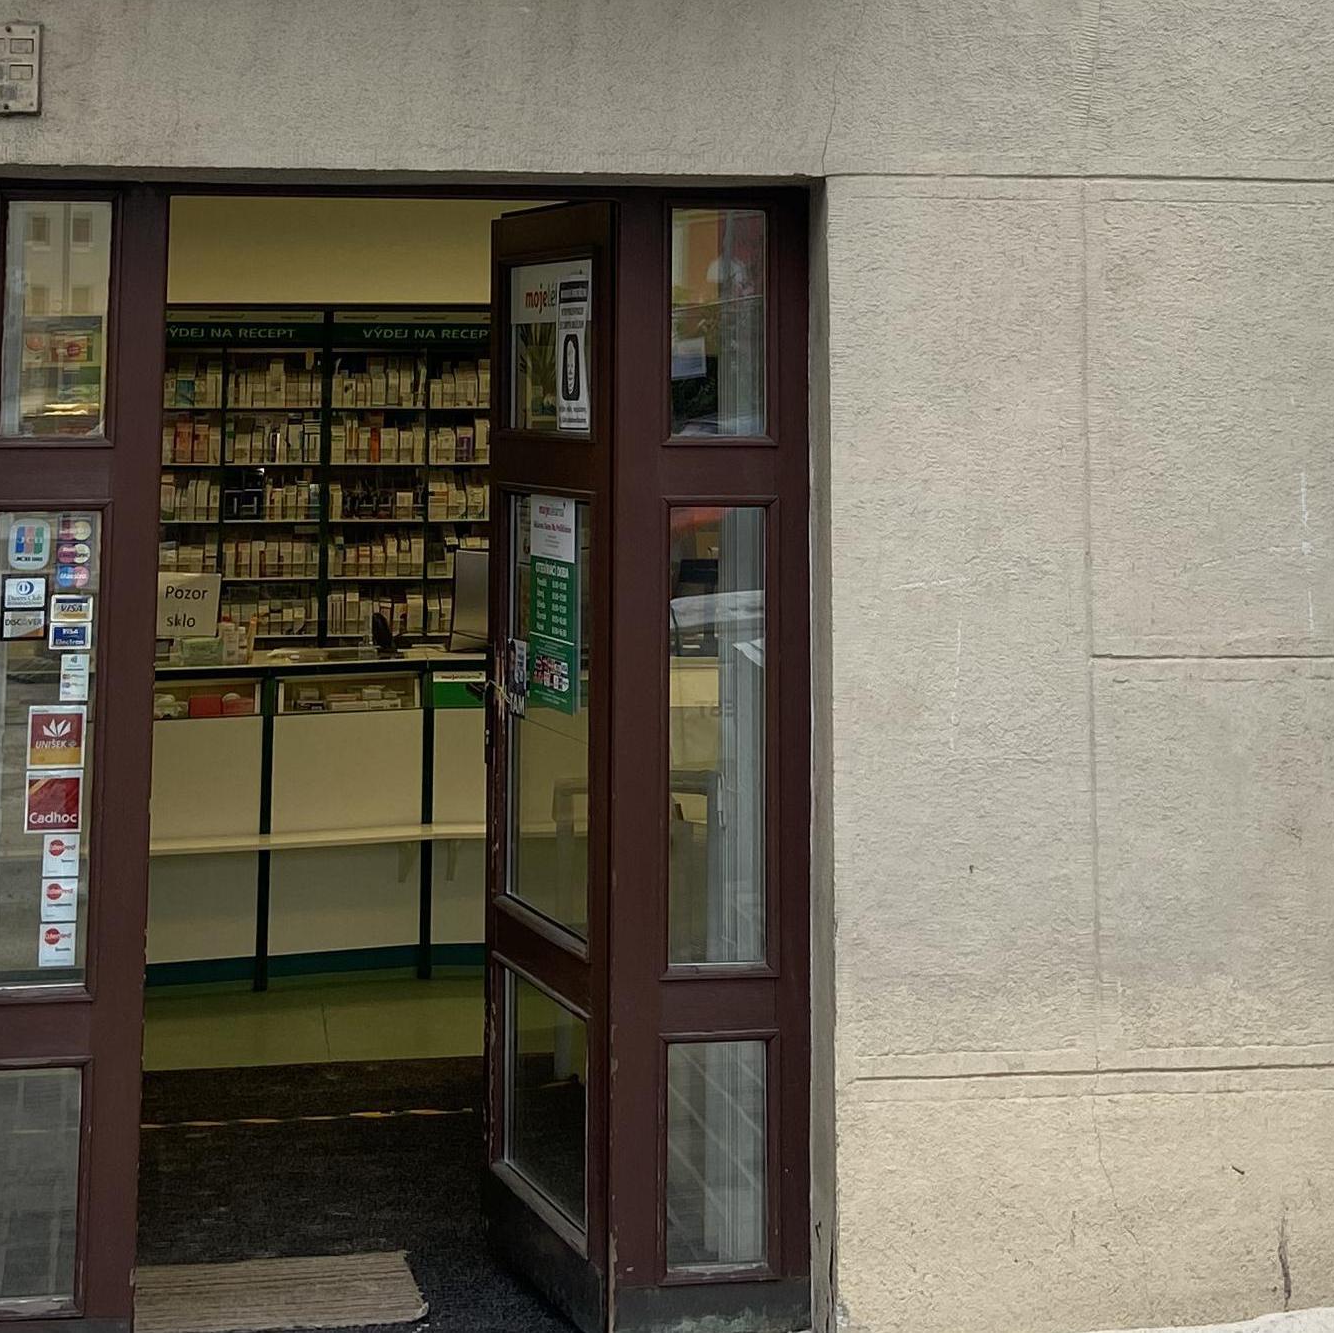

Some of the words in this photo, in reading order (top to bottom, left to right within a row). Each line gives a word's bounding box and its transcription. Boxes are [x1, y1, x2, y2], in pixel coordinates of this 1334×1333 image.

[166, 324, 205, 339] ÝDEJ
[210, 327, 233, 339] NA
[238, 327, 297, 340] RECEPT
[362, 324, 409, 340] VÝDEJ
[413, 327, 436, 340] NA
[440, 327, 491, 340] RECEP
[165, 585, 208, 600] Pozor
[60, 603, 84, 613] VISA
[4, 618, 43, 626] DISCOVER
[166, 613, 196, 628] sklo
[35, 738, 68, 749] UNIŠEK
[29, 811, 78, 824] Cadhoc
